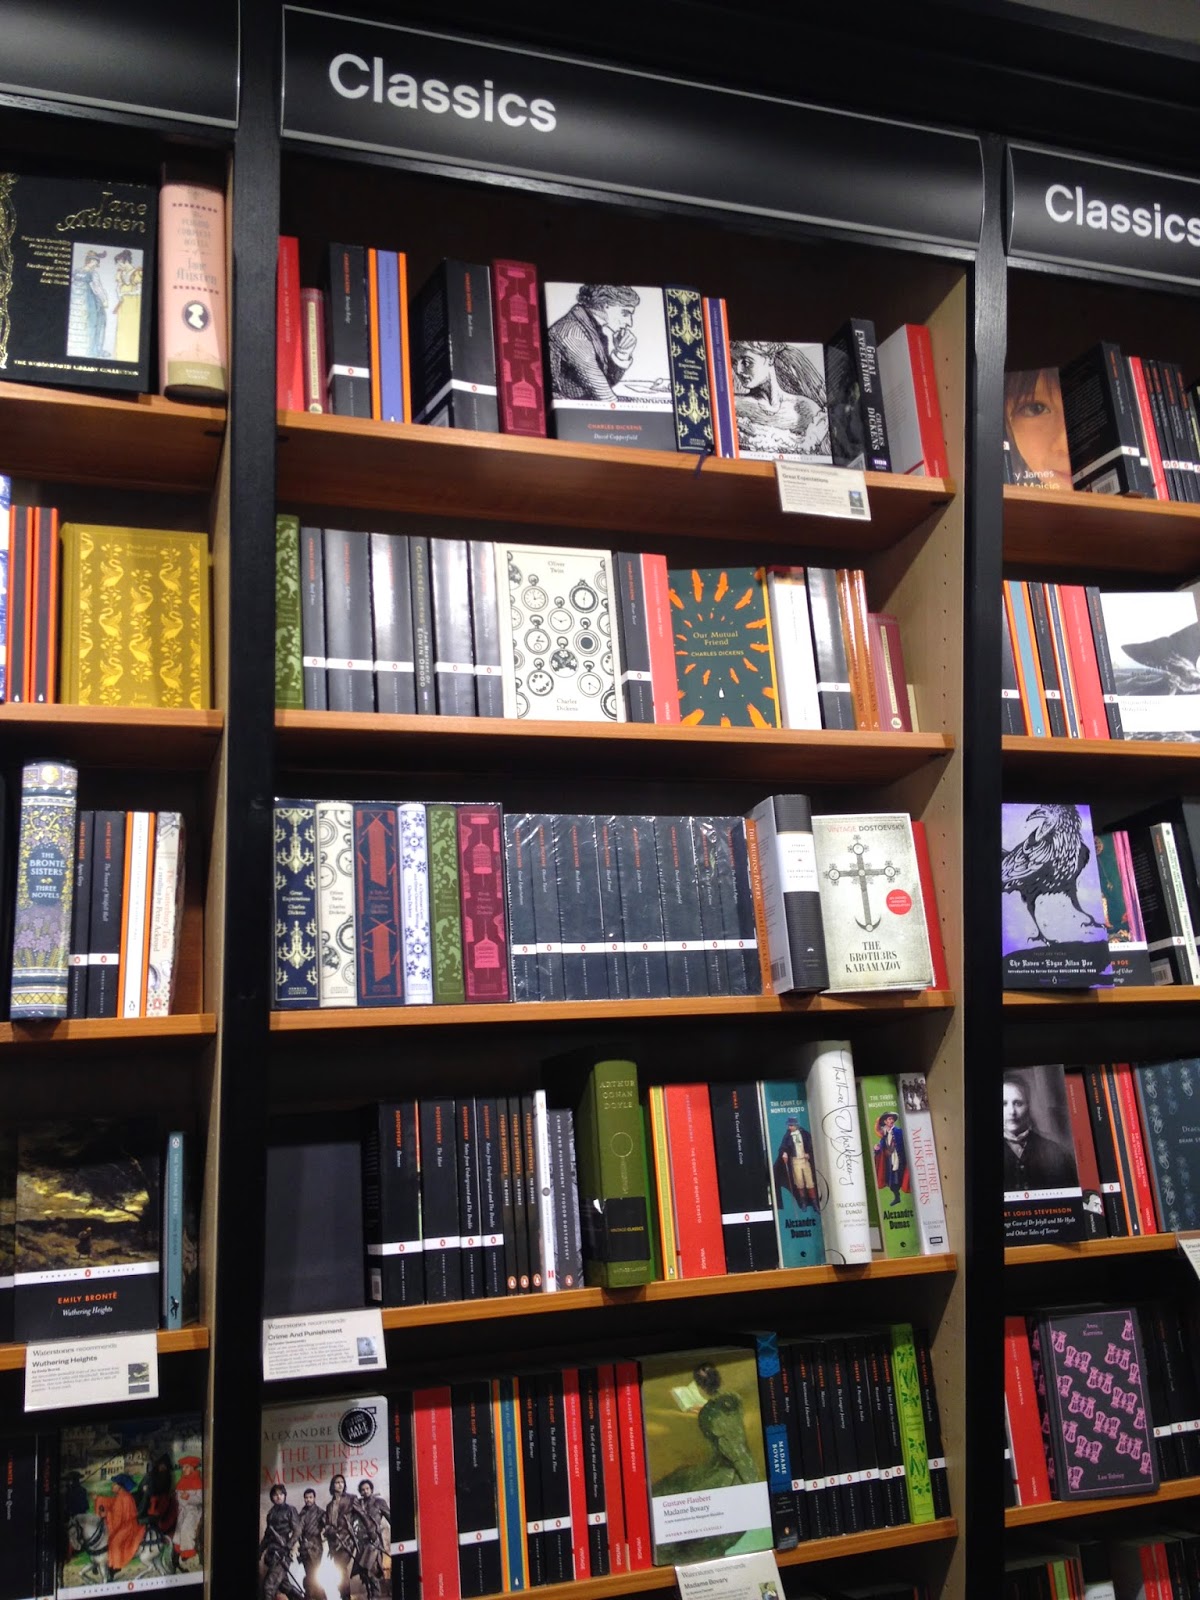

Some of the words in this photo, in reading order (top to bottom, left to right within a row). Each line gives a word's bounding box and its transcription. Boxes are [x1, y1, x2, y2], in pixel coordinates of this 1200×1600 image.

[328, 52, 557, 133] Classics
[103, 192, 148, 216] Jane
[56, 209, 146, 233] Austen
[1045, 184, 1200, 247] Classics
[855, 329, 872, 393] EXPECTATIONS
[866, 346, 876, 376] GREAT
[867, 407, 880, 451] DICKENS
[875, 413, 886, 447] CHARLES
[1023, 471, 1054, 479] James
[693, 631, 708, 639] Our
[710, 631, 738, 639] Mutual
[704, 638, 729, 646] Friend
[556, 704, 579, 712] Dickens
[859, 824, 905, 832] DOSTOEVSKY
[750, 843, 759, 873] MUDFOG
[30, 868, 63, 876] SISTERS
[35, 885, 57, 893] THREE
[165, 886, 174, 927] Canterbury
[862, 941, 881, 950] THE
[846, 961, 901, 973] KARAMAZOV
[1045, 960, 1062, 968] Edgar
[600, 1080, 635, 1089] ARTHUR
[603, 1091, 633, 1099] CONAN
[604, 1102, 633, 1110] DOYLE
[923, 1138, 933, 1157] THE
[912, 1127, 929, 1205] MUSKETEERS
[927, 1159, 939, 1194] THREE
[883, 1209, 914, 1220] Alexandre
[785, 1218, 817, 1228] Alexandre
[889, 1221, 910, 1230] Dumas
[1035, 1218, 1047, 1227] Jekyll
[1065, 1216, 1076, 1225] Hyde
[791, 1229, 812, 1239] Dumas
[1040, 1228, 1044, 1236] of
[57, 1294, 83, 1305] EMILY
[85, 1292, 118, 1302] BRONTË
[62, 1307, 91, 1318] Wuthering
[92, 1306, 113, 1315] Heights
[268, 1322, 307, 1330] Waterstones
[304, 1328, 343, 1337] Punishment
[33, 1348, 75, 1357] Waterstones
[76, 1344, 118, 1352] recommends
[32, 1359, 70, 1368] Wuthering
[71, 1356, 98, 1364] Heights
[263, 1426, 332, 1441] ALEXANDRE
[347, 1422, 367, 1434] HALF
[348, 1427, 368, 1440] PRICE
[282, 1446, 309, 1464] THE
[315, 1442, 364, 1461] THREE
[778, 1440, 787, 1475] MADAME
[262, 1458, 379, 1487] MUSKETEERS
[663, 1500, 686, 1508] Gustave
[687, 1495, 711, 1504] Flaubert
[664, 1508, 689, 1517] Madame
[690, 1505, 710, 1513] Bovary
[684, 1580, 709, 1590] Madame
[709, 1577, 729, 1585] Bovary
